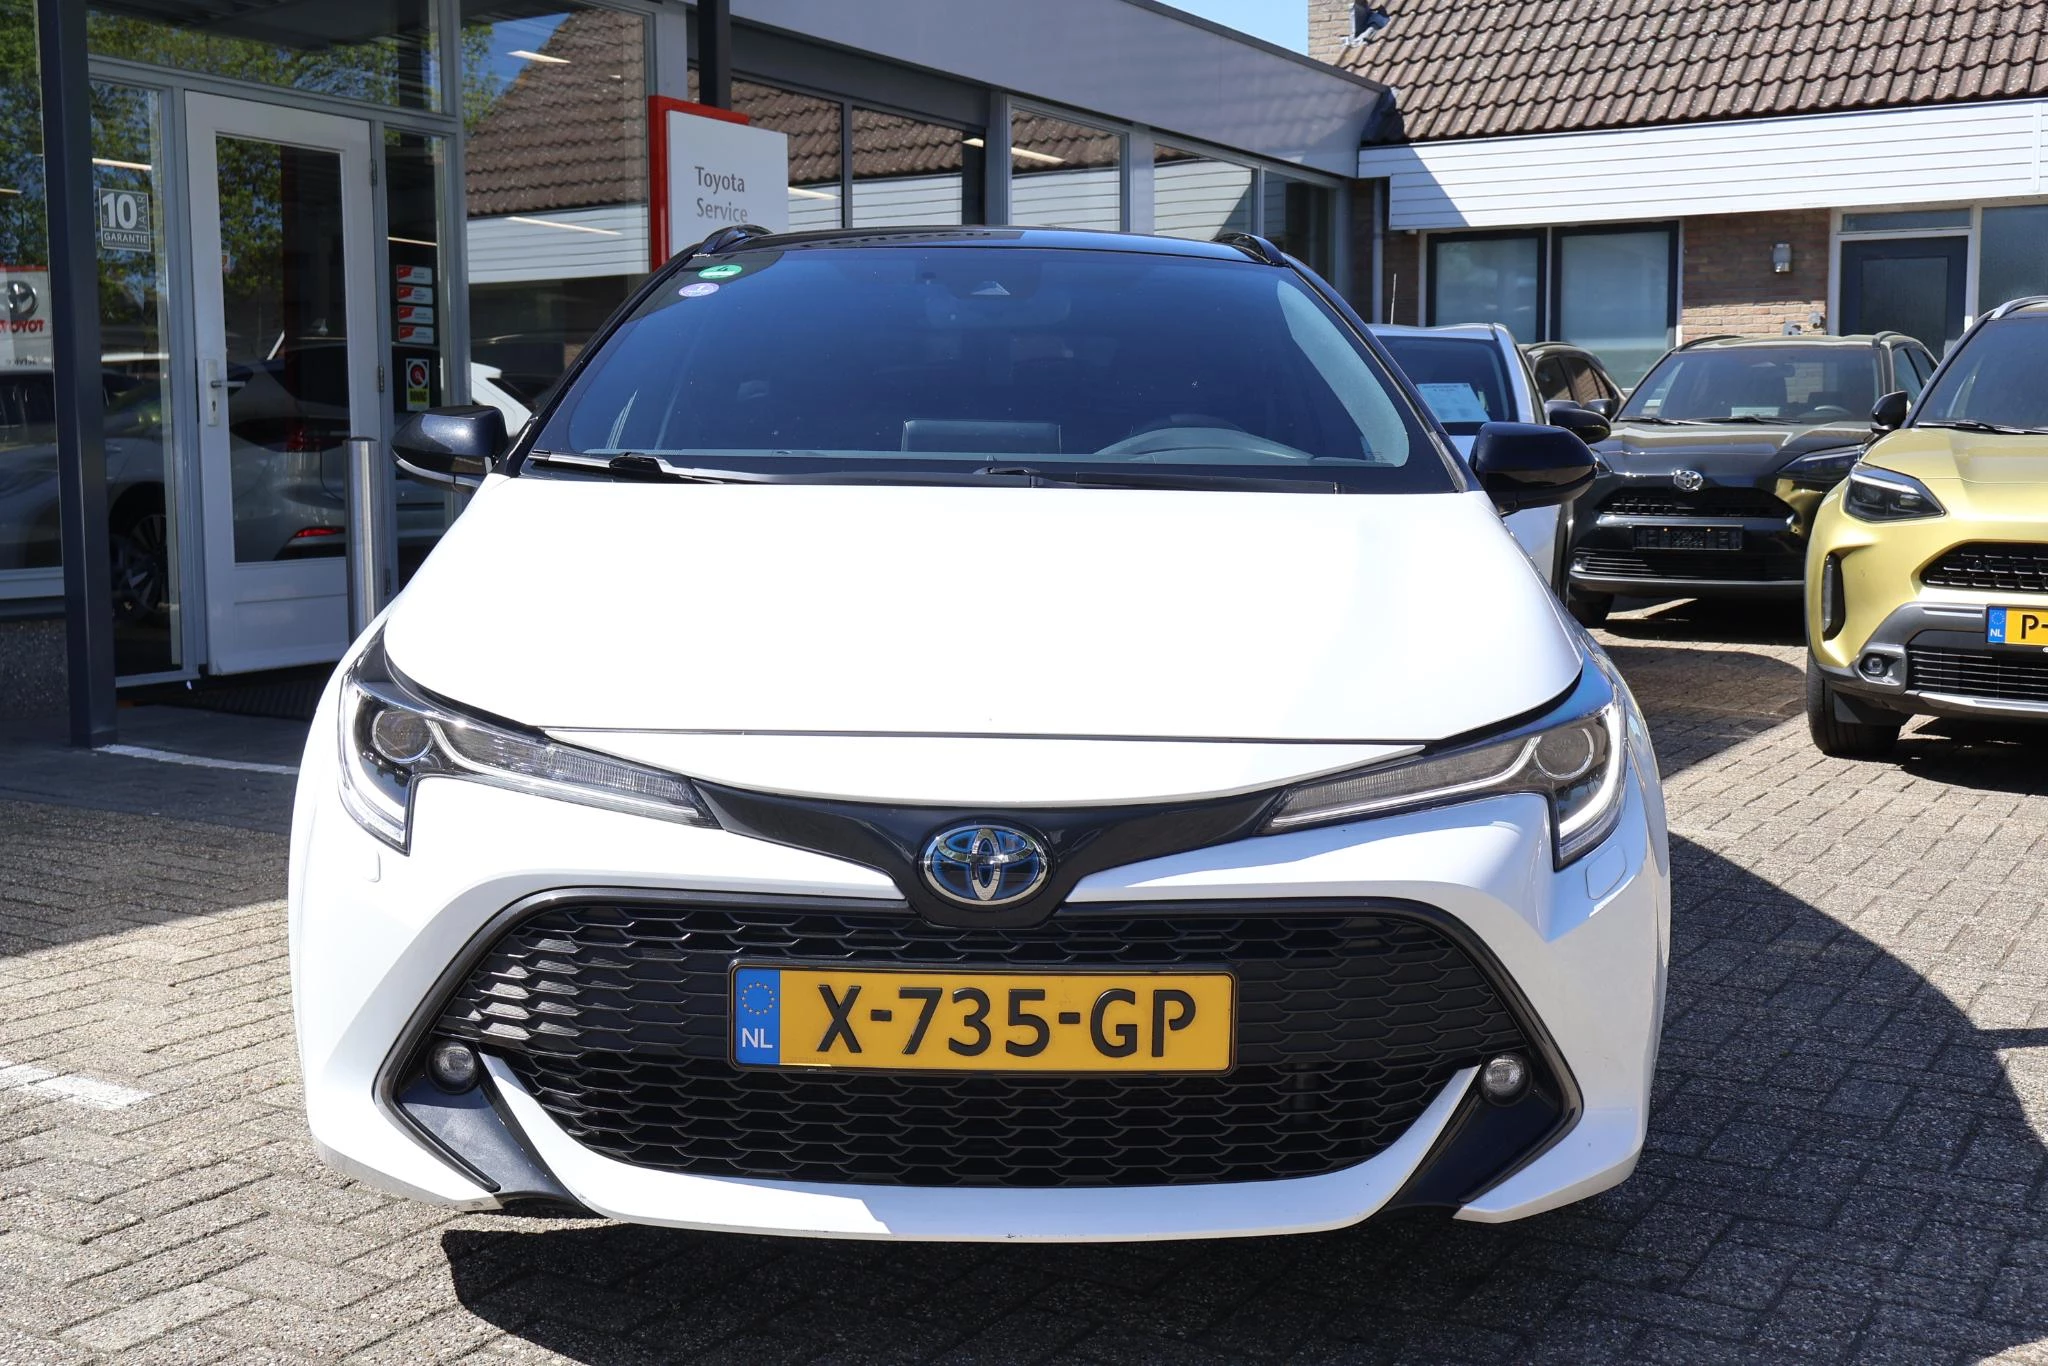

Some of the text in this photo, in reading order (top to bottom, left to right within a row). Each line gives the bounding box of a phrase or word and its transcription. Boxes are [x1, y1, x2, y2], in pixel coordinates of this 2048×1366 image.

[694, 166, 745, 194] Toyota
[102, 192, 137, 229] 10
[697, 197, 748, 223] Service
[104, 232, 148, 244] GARANTIE
[1990, 628, 2003, 637] NL
[815, 983, 1197, 1058] X-735-GP
[741, 1027, 773, 1049] NL
